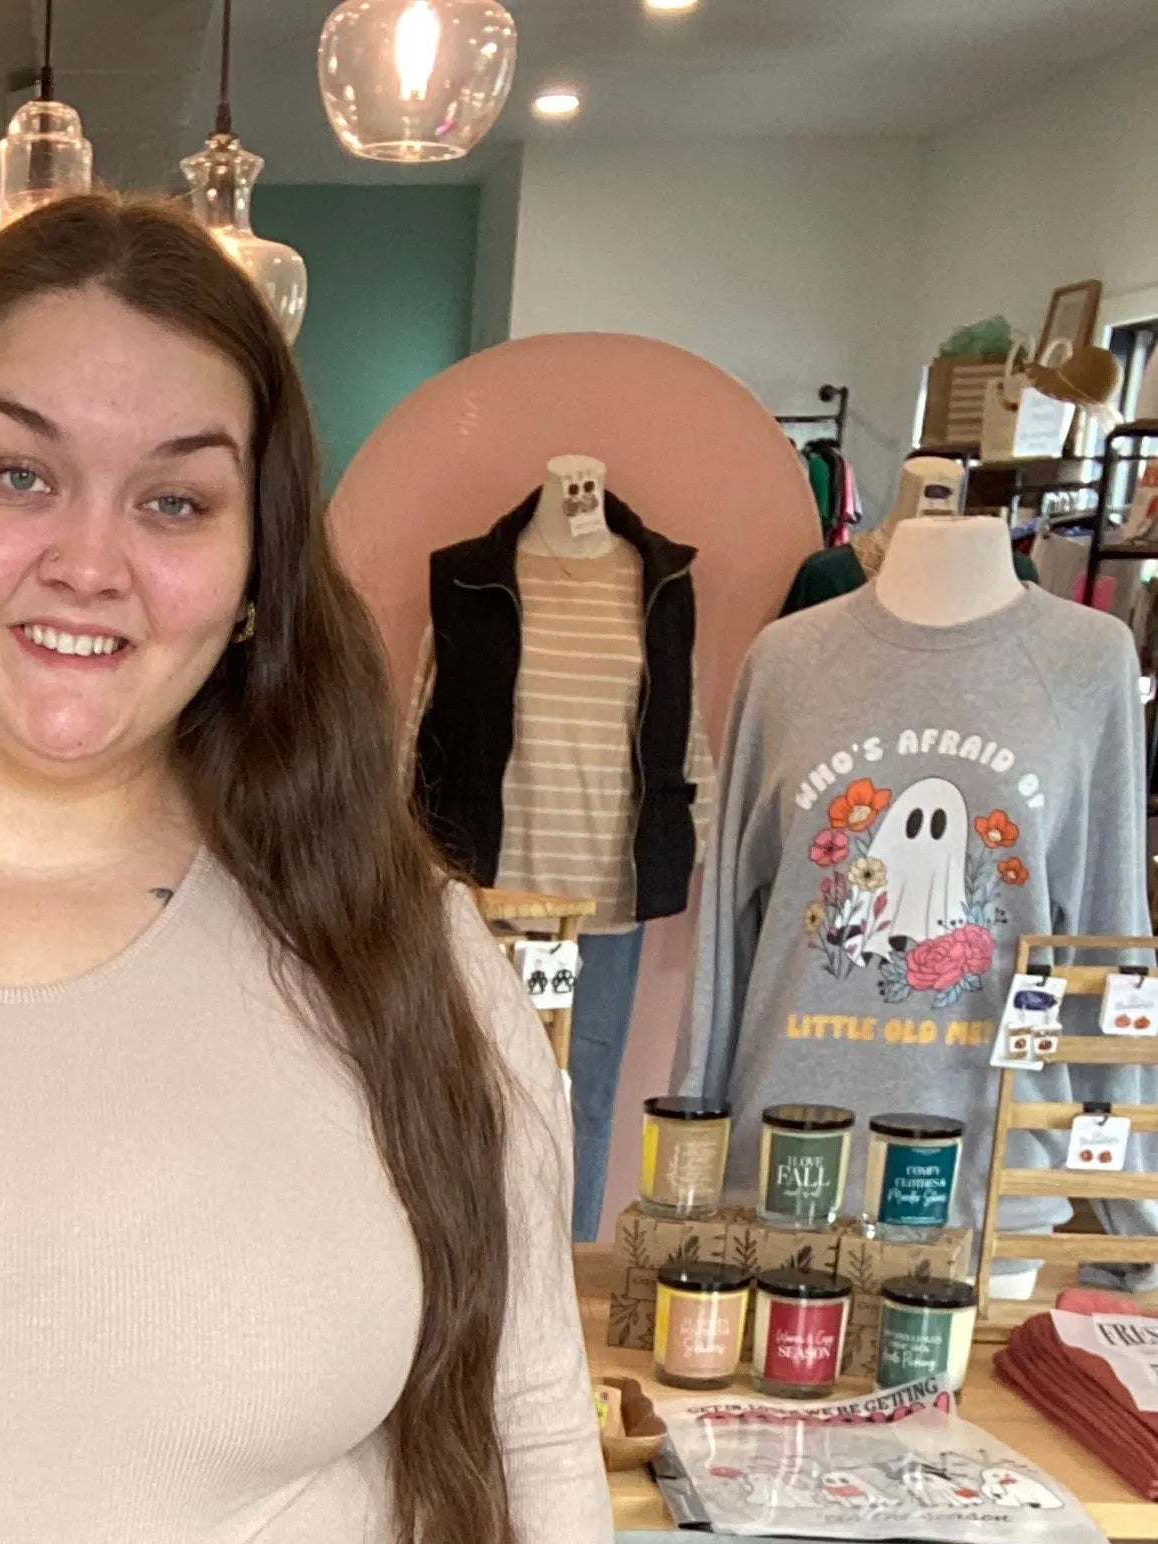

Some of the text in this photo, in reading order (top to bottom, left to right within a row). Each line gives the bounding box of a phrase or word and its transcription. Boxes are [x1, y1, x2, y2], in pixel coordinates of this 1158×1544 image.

[795, 736, 884, 810] WHO'S
[897, 728, 1015, 773] AFRAID
[786, 1013, 876, 1041] LITTLE
[884, 1018, 938, 1044] OLD
[776, 1163, 831, 1187] FALL
[777, 1345, 830, 1359] SEASON
[864, 1376, 939, 1414] GETTING
